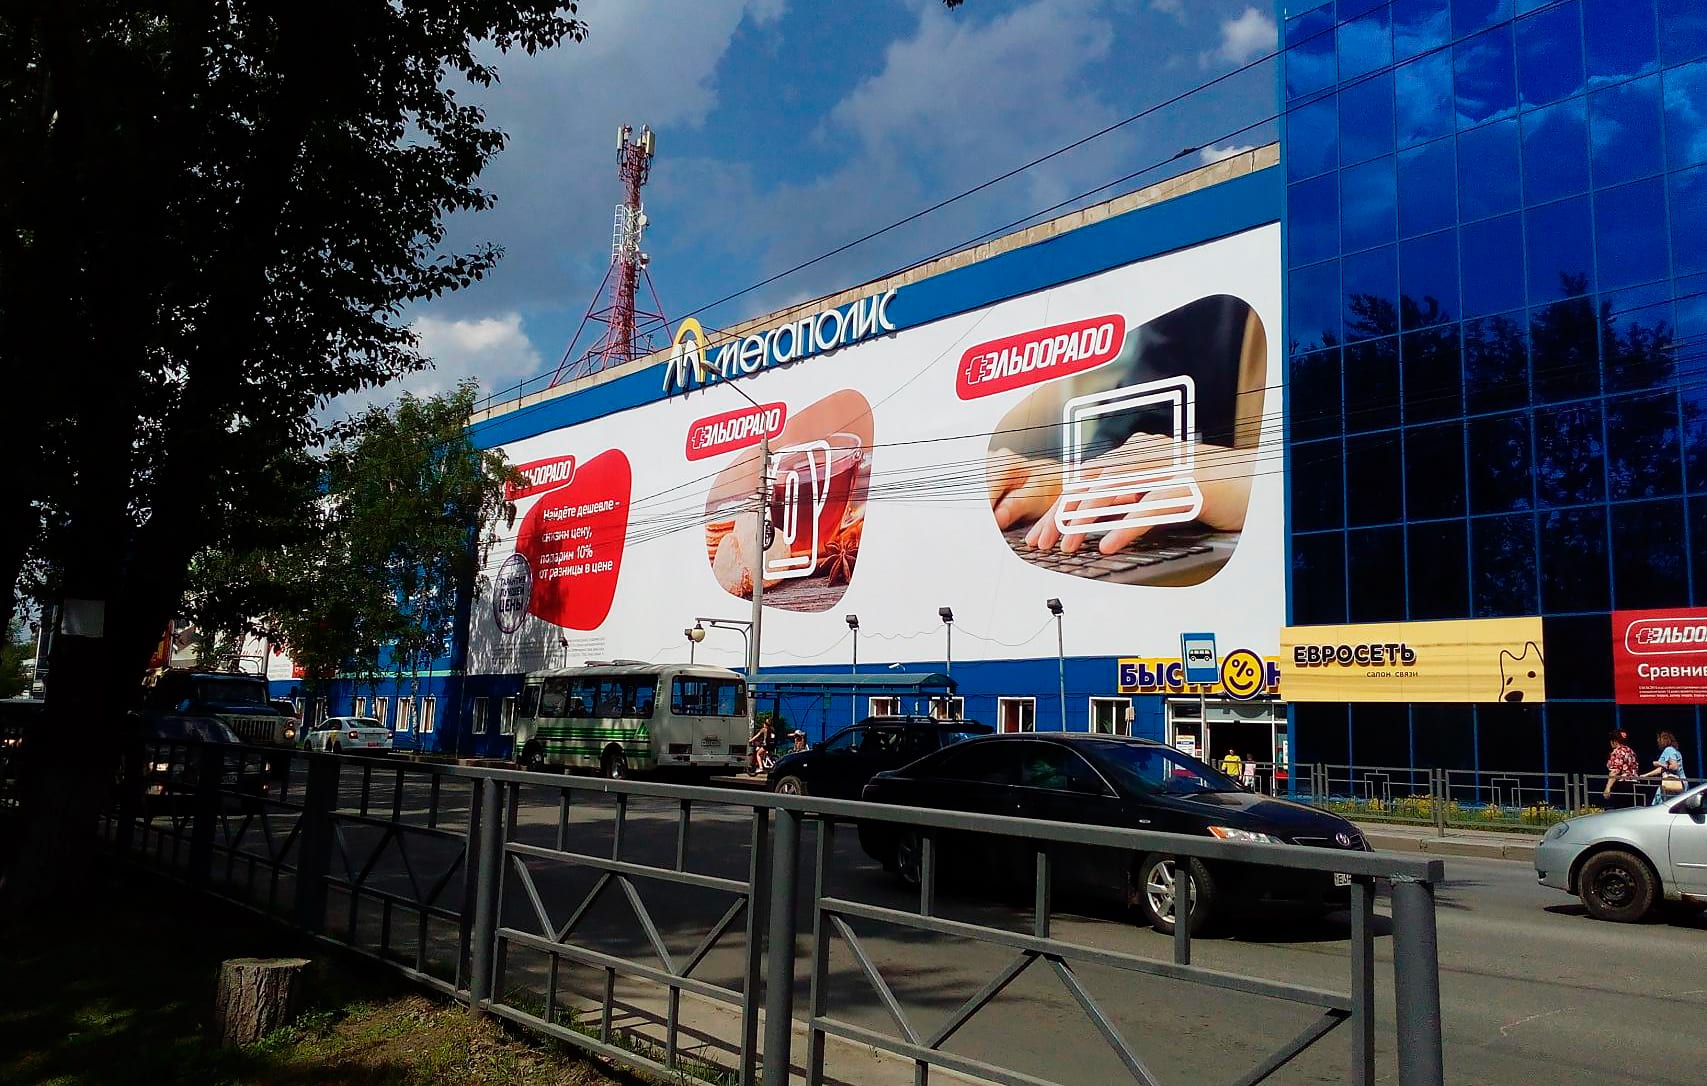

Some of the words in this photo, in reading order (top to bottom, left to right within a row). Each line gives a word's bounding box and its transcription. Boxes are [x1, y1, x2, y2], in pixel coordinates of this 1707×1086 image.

[577, 500, 614, 518] дешевле
[577, 544, 593, 559] 10%
[539, 568, 549, 579] от
[549, 564, 583, 581] разницы
[584, 563, 591, 574] в
[592, 560, 613, 574] цене
[1293, 643, 1416, 666] ЕВРОСЕТЬ
